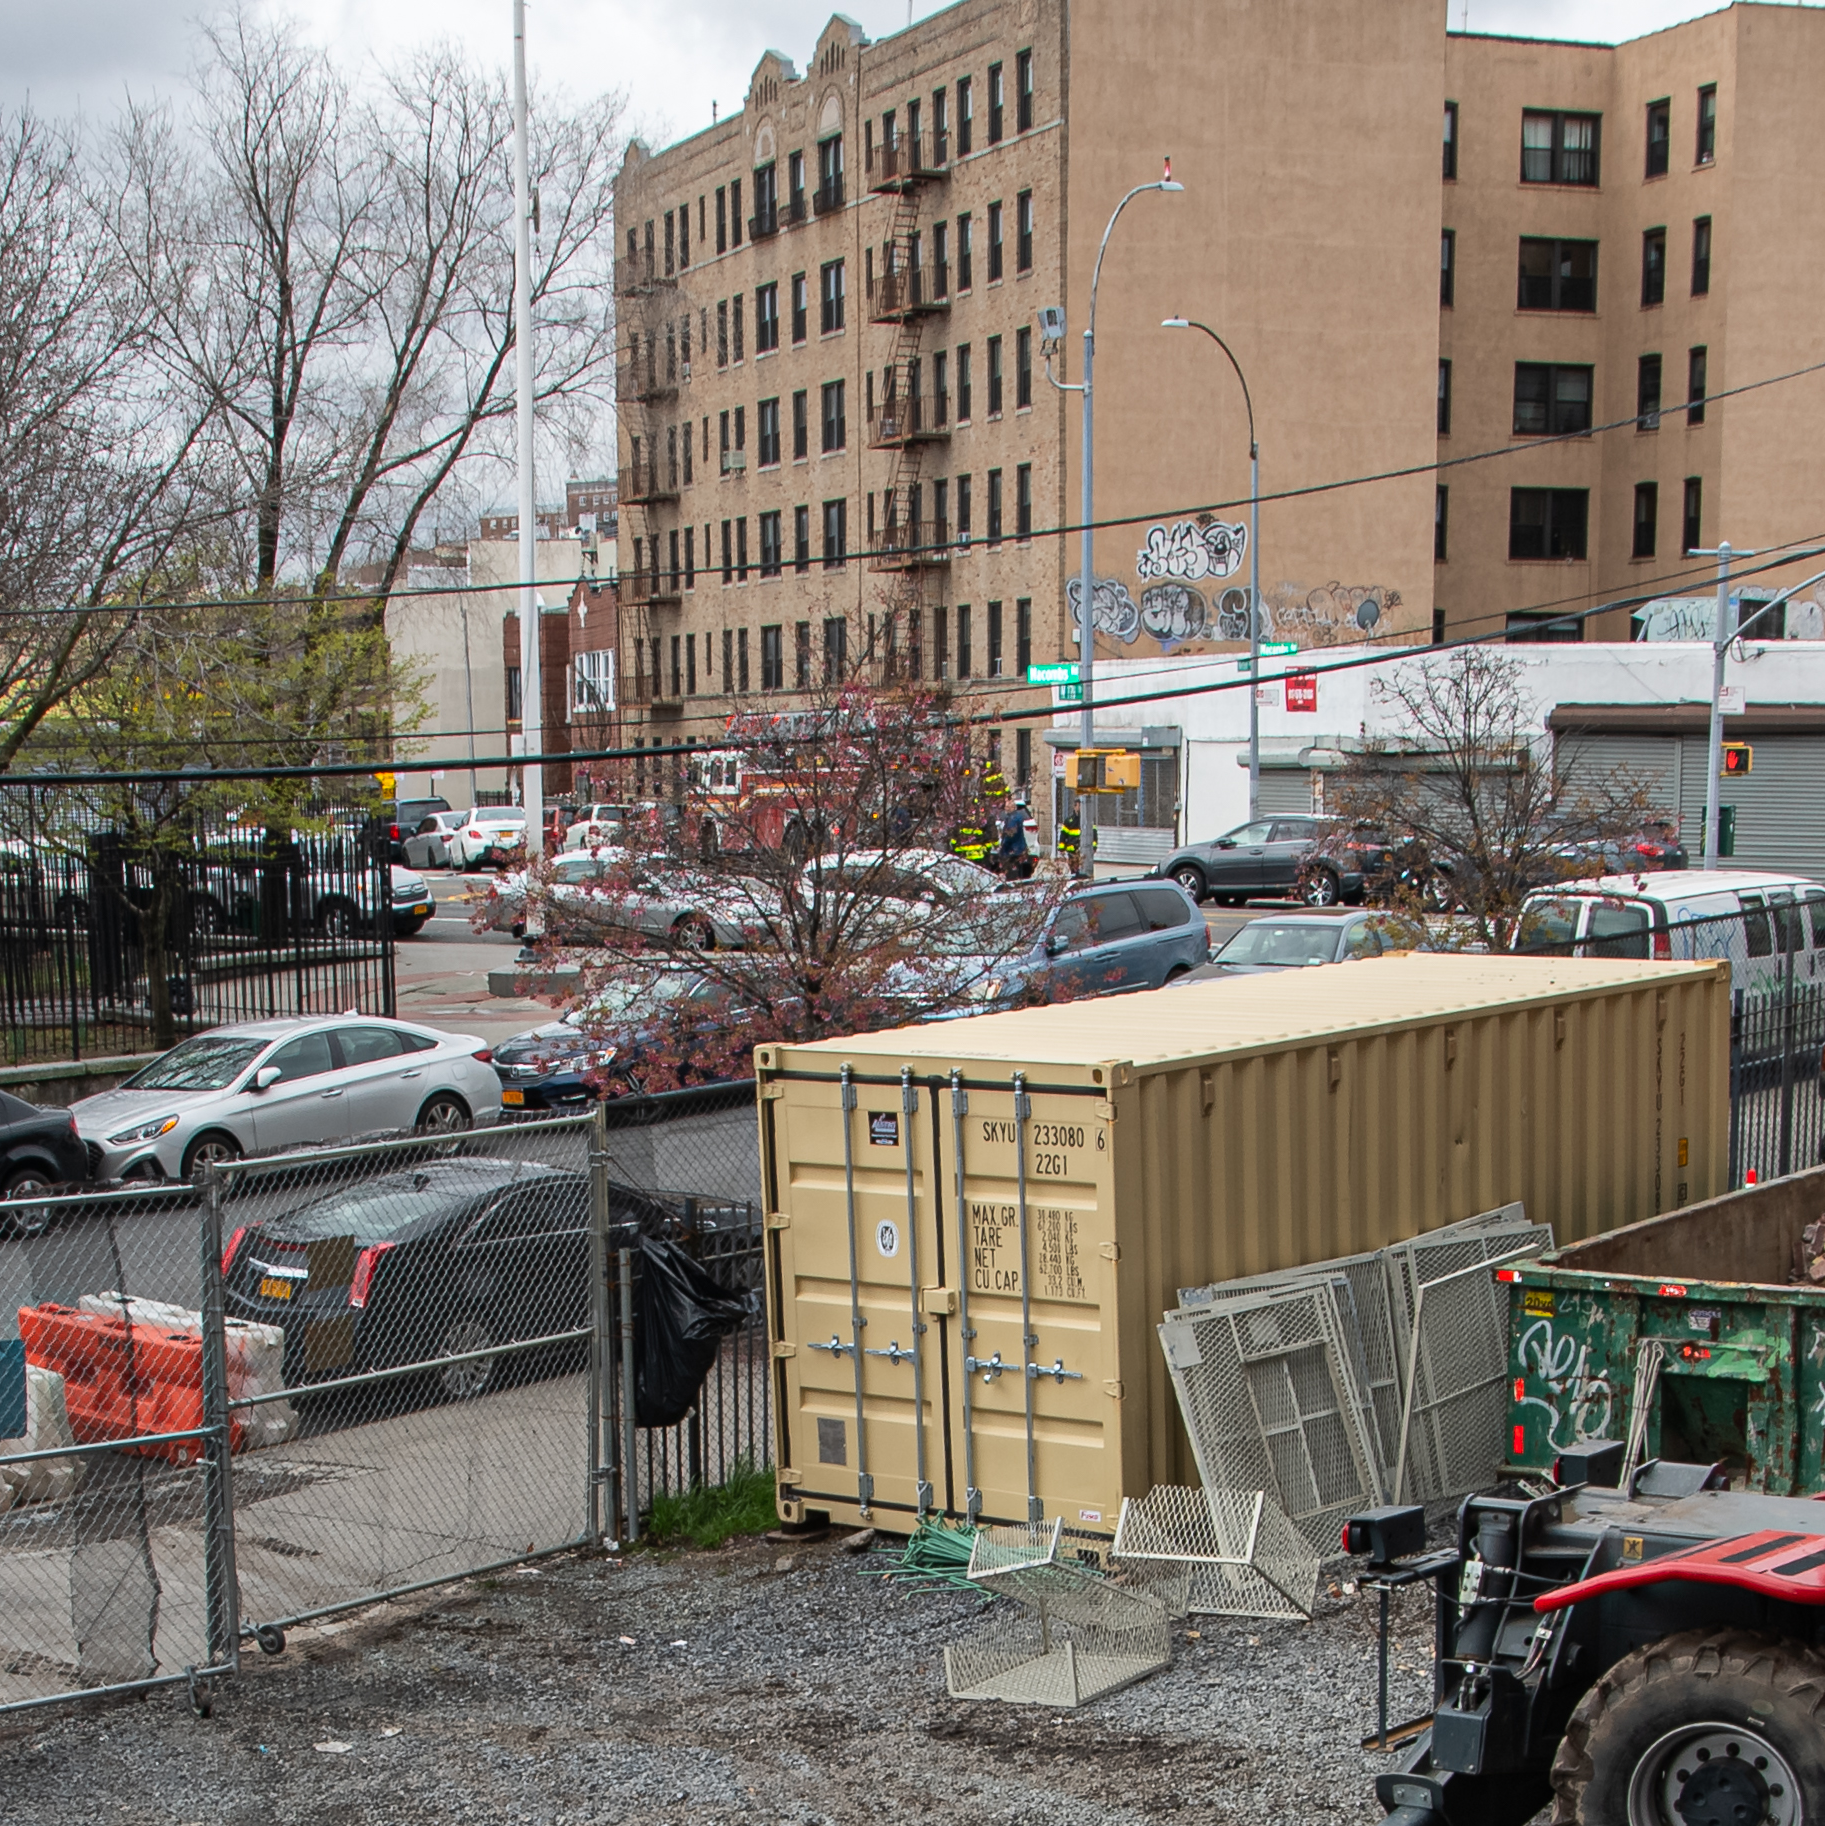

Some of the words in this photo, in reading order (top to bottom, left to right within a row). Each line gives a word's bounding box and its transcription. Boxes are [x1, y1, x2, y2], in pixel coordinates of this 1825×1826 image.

[1030, 666, 1069, 682] Macombs
[982, 1121, 1016, 1143] SKYU
[1033, 1124, 1085, 1148] 233080
[1097, 1129, 1106, 1151] 6
[1035, 1153, 1068, 1175] 22G1
[973, 1226, 1003, 1248] TARE
[974, 1248, 996, 1268] NET
